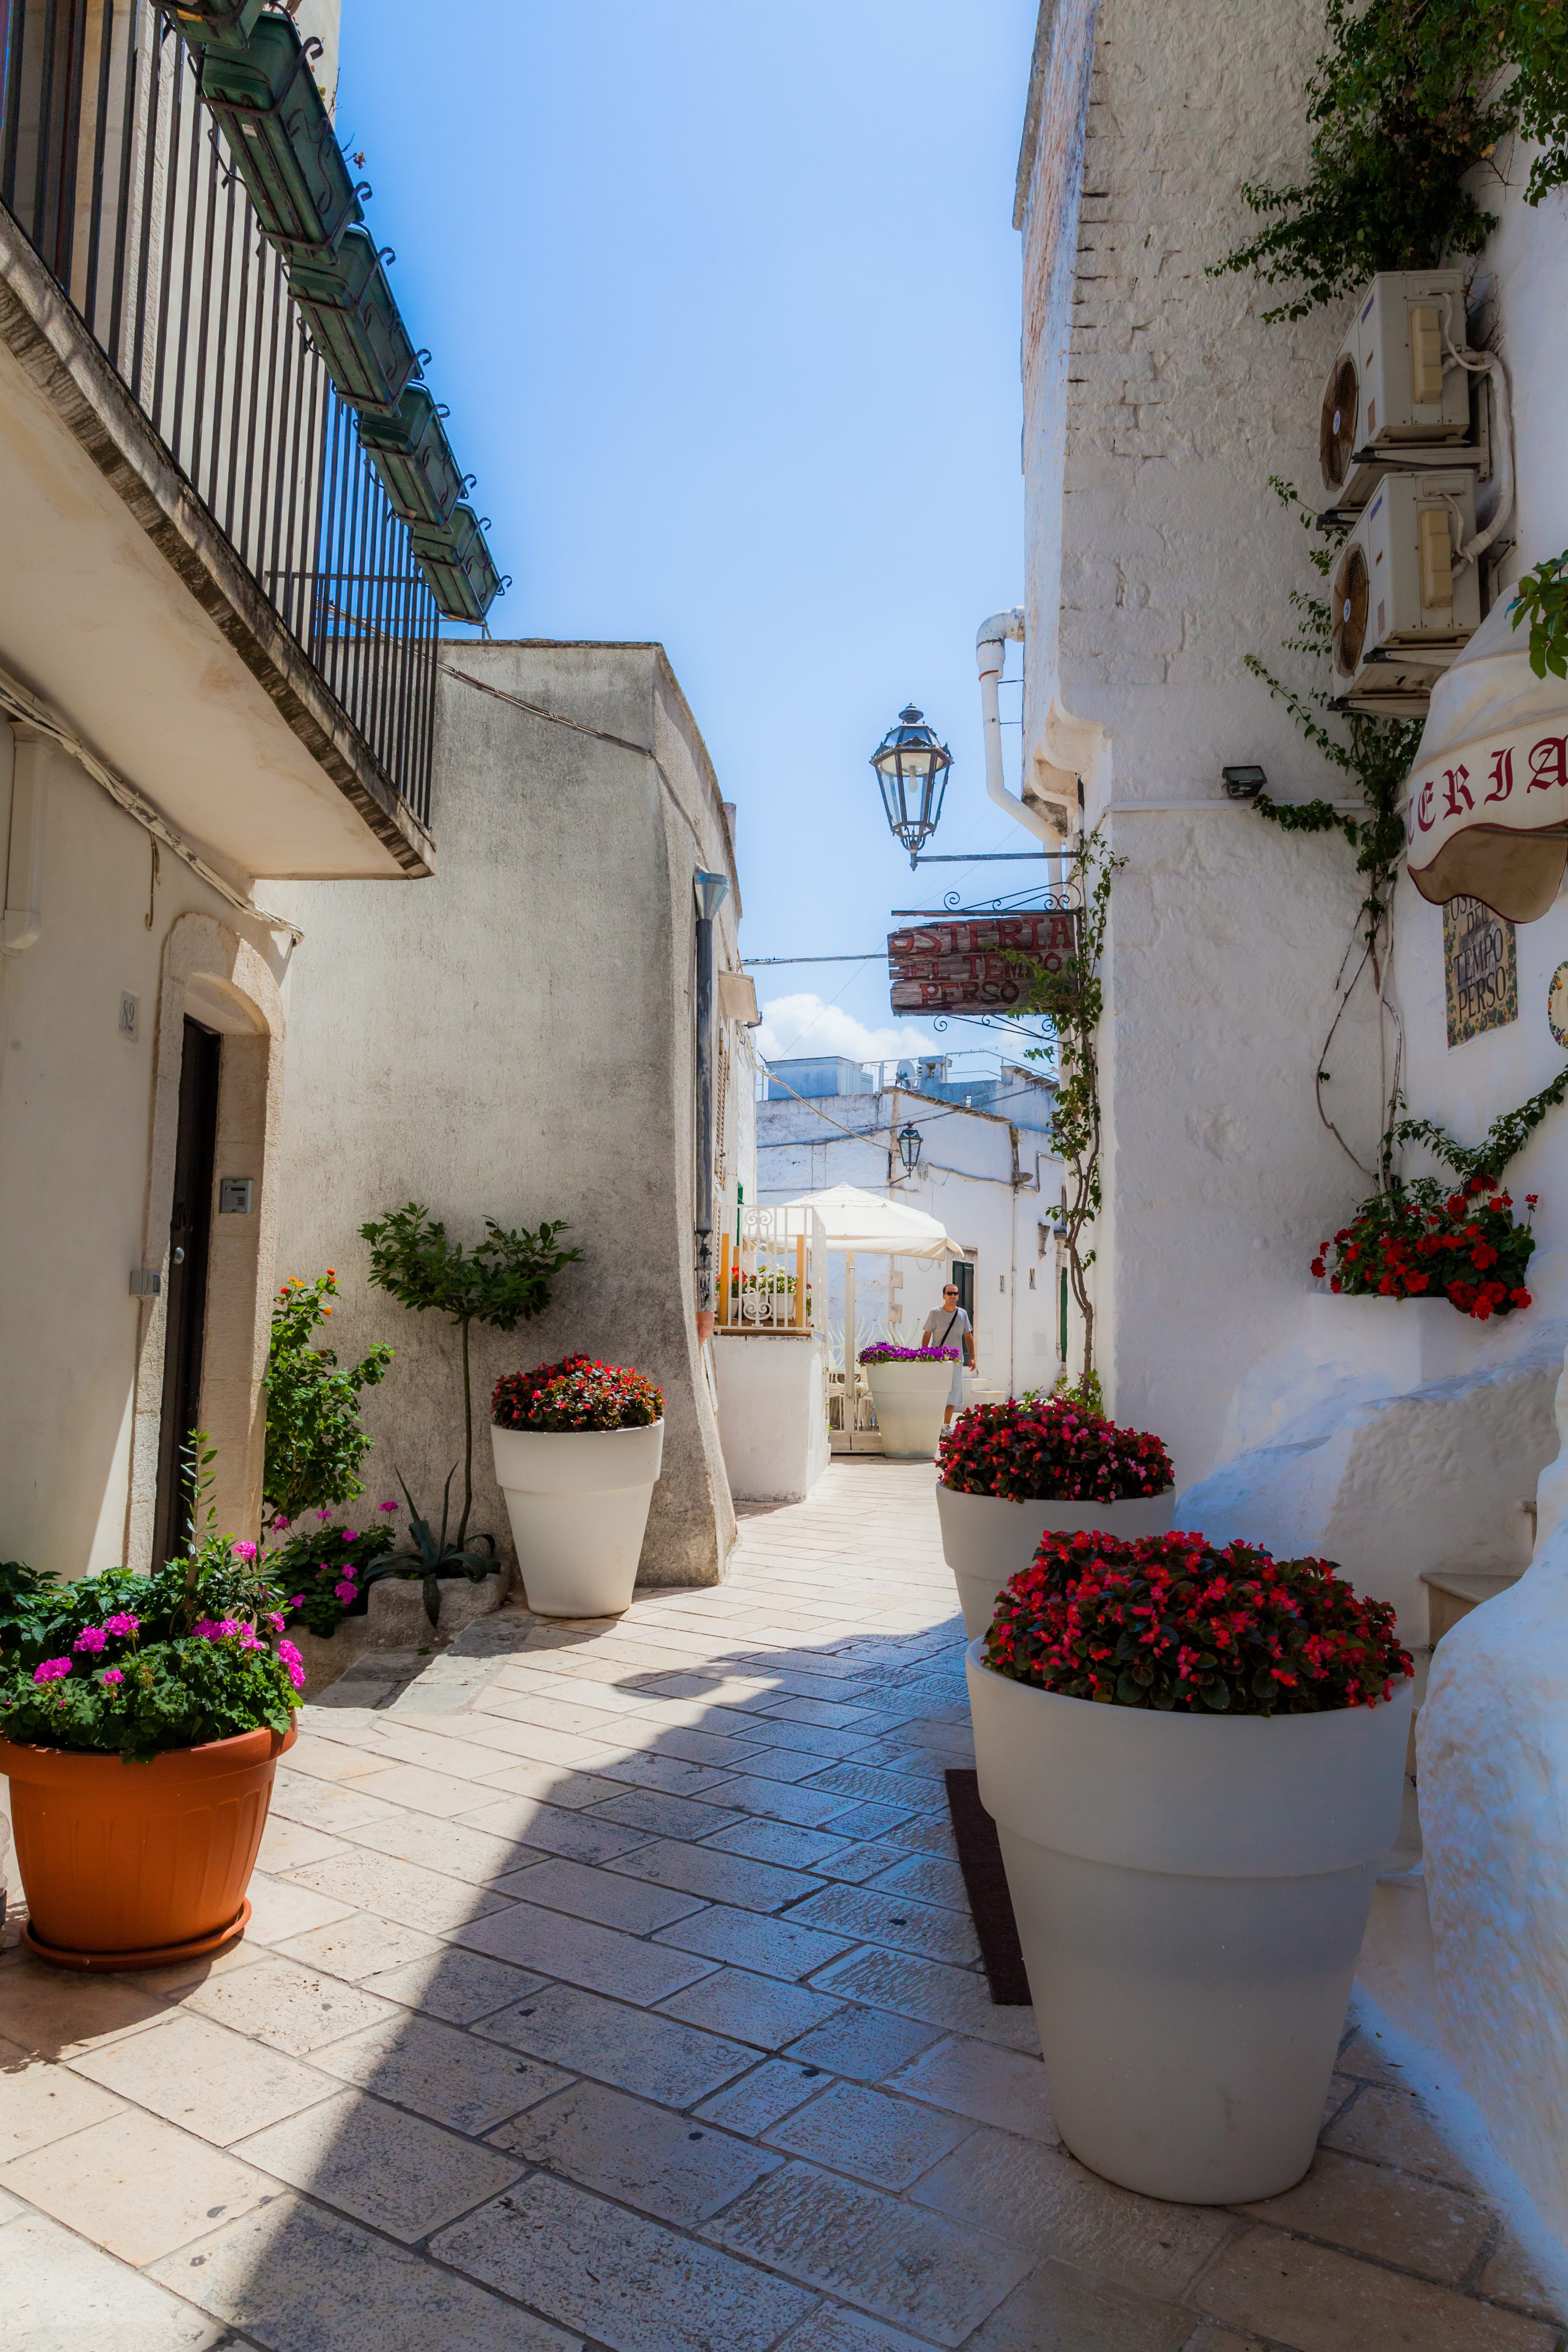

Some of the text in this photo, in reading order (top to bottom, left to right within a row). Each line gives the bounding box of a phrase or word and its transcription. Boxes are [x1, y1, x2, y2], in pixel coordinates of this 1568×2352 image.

[1467, 903, 1489, 935] DEL
[1453, 928, 1503, 986] TEMPO
[920, 980, 1019, 1004] PERSO
[1458, 966, 1506, 1023] PERSO
[122, 1000, 134, 1032] 82
